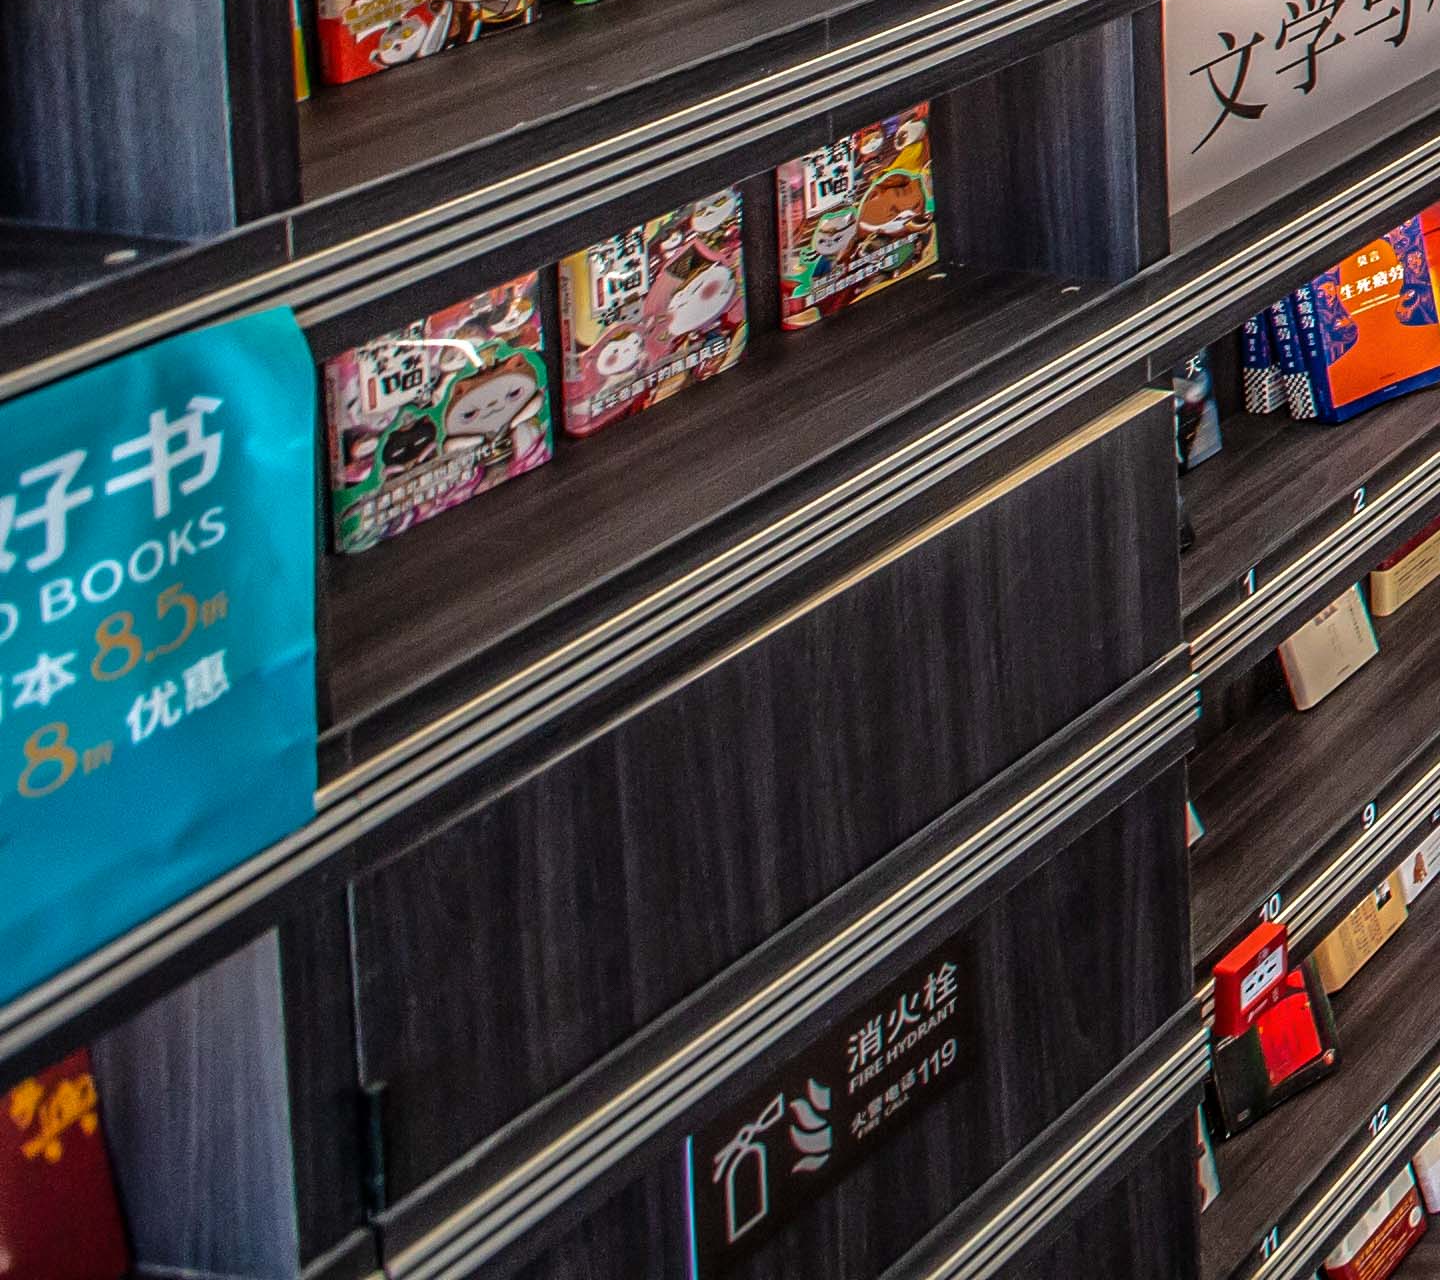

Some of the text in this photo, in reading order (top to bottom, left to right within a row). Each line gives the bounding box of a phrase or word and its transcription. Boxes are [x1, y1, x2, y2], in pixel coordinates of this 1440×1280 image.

[1339, 264, 1405, 303] 生死疲劳
[0, 395, 224, 574] 好书
[1352, 486, 1367, 514] 2
[38, 505, 228, 624] BOOKS
[1242, 567, 1255, 594] 1
[1362, 800, 1377, 829] 9
[1259, 893, 1282, 922] 10
[848, 960, 959, 1074] 消火栓
[849, 997, 959, 1096] FIRE HYDRANT
[1368, 1104, 1390, 1137] 12
[1259, 1226, 1279, 1258] 11
